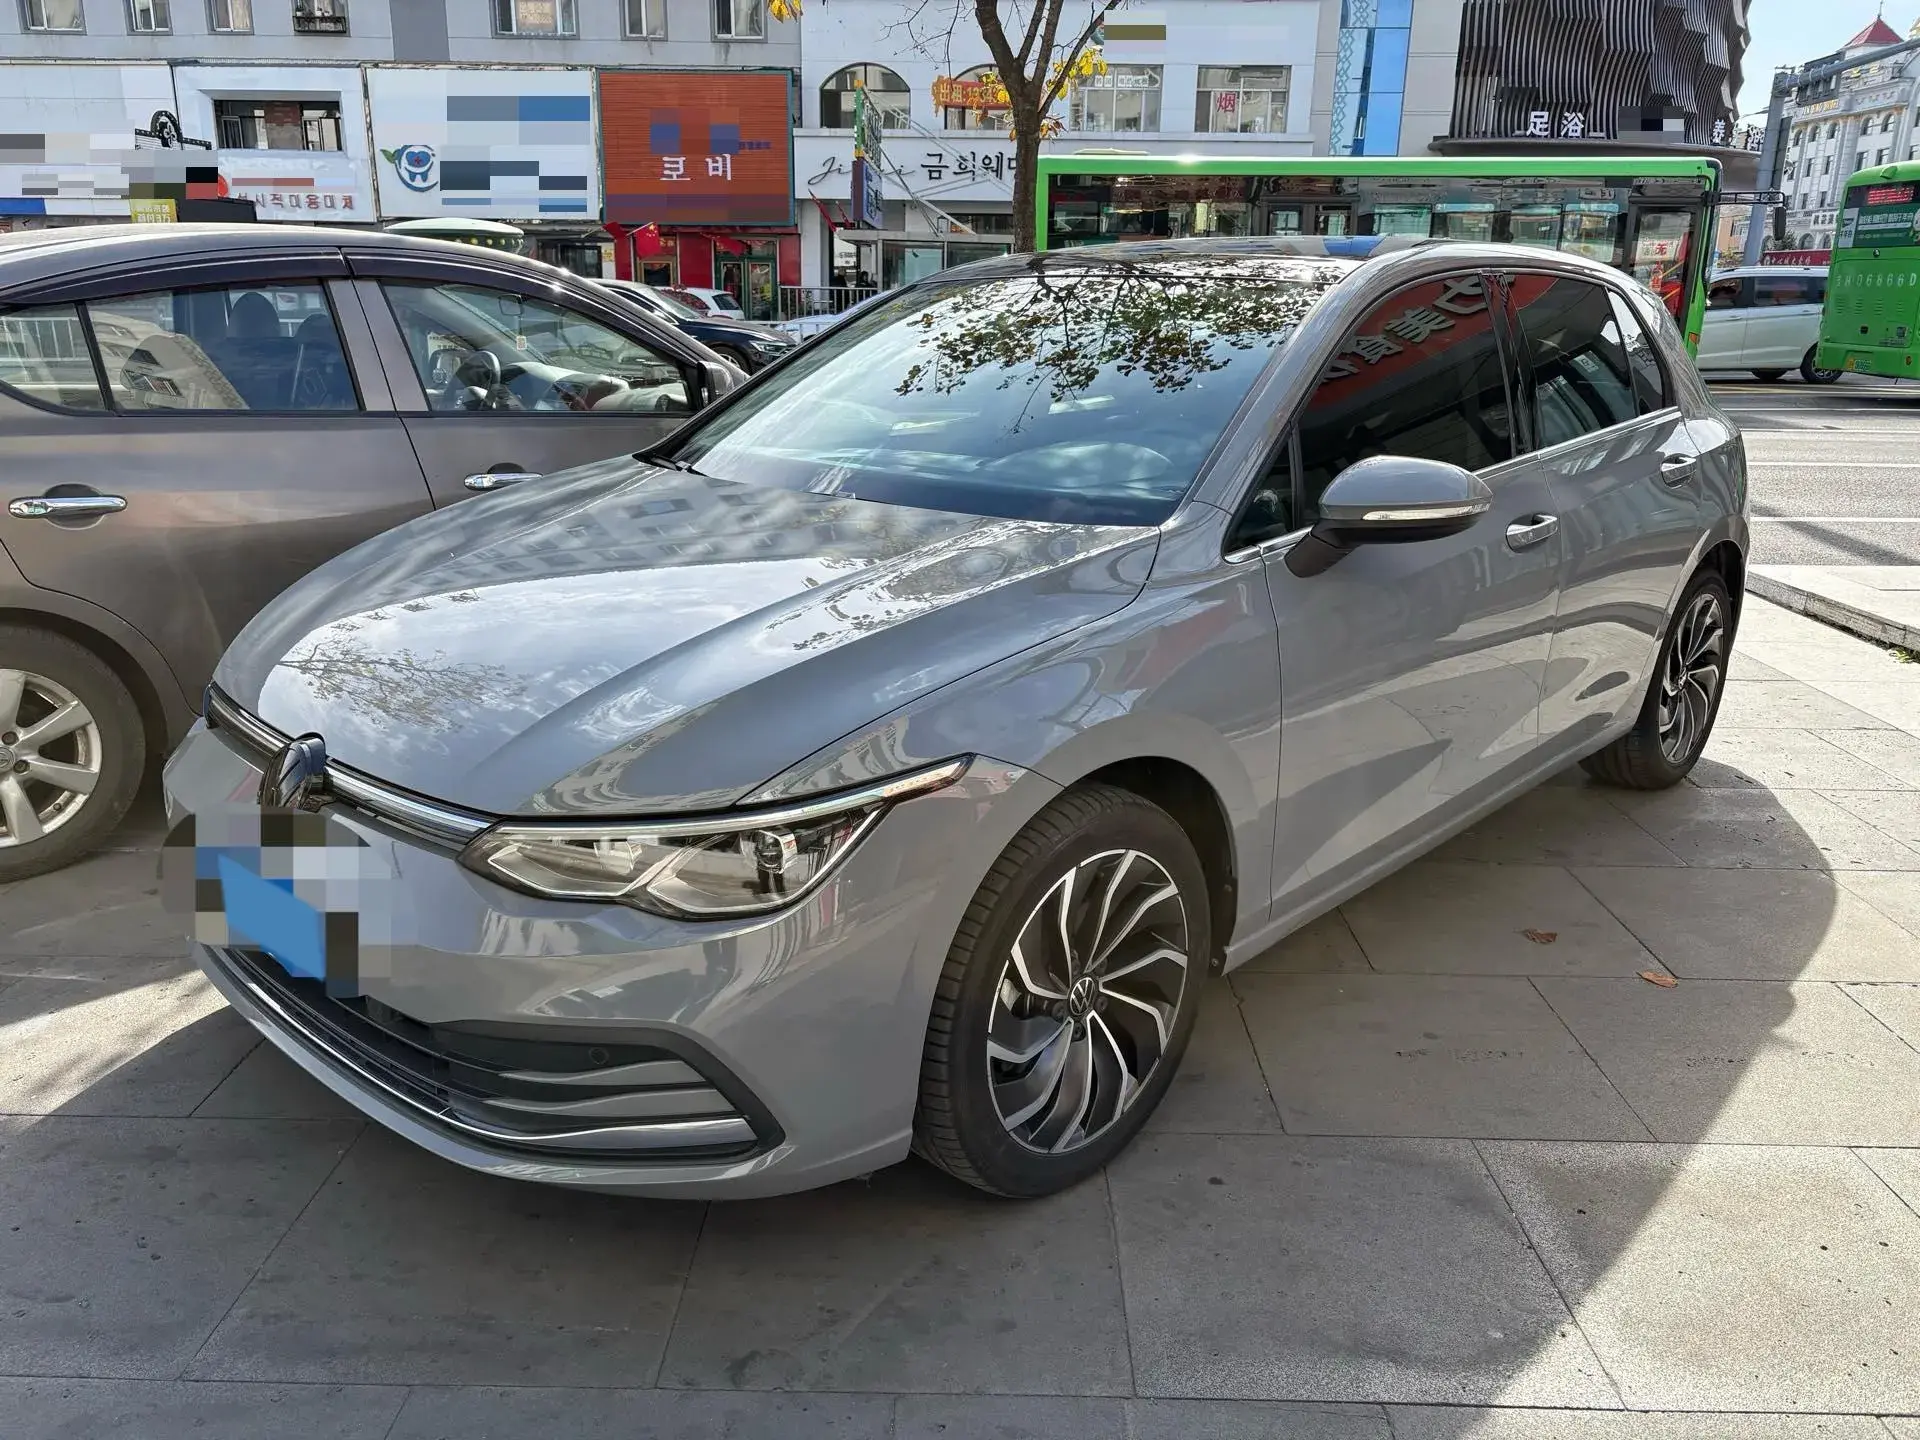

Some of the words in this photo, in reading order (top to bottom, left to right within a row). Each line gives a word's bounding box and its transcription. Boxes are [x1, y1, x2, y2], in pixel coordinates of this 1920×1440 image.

[1217, 92, 1236, 113] 烟
[1526, 111, 1585, 137] 足浴
[659, 153, 732, 181] 코비
